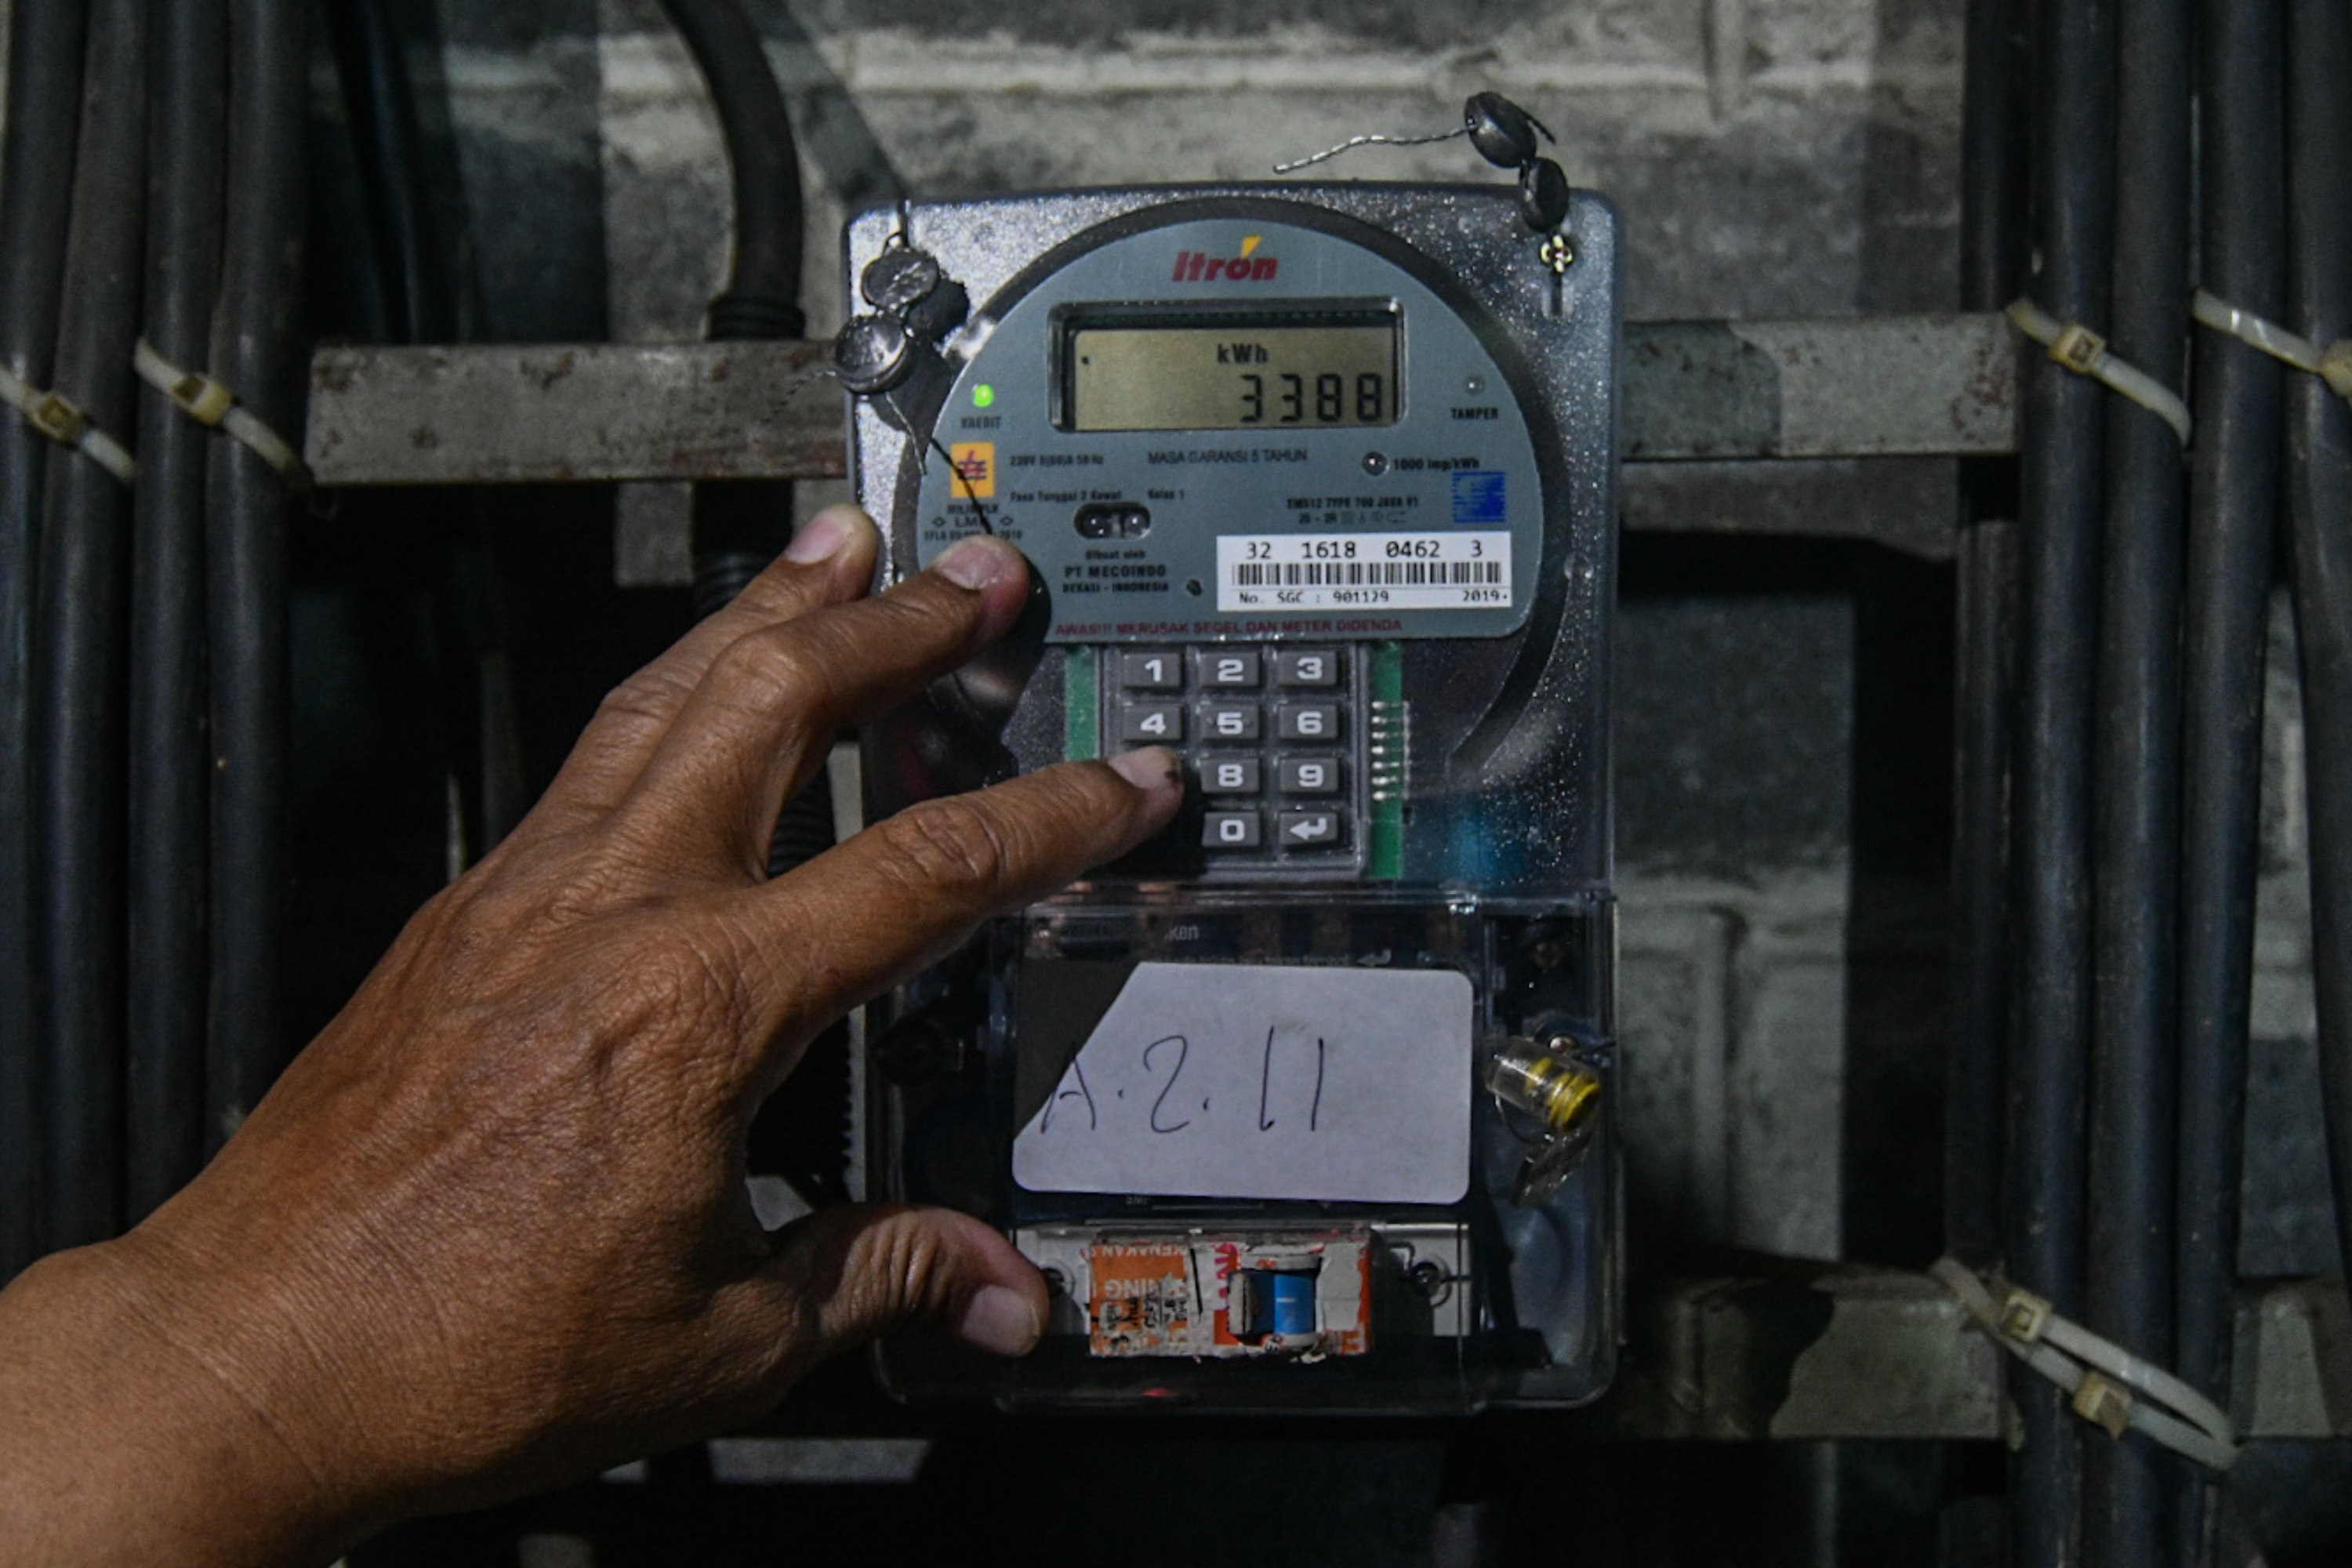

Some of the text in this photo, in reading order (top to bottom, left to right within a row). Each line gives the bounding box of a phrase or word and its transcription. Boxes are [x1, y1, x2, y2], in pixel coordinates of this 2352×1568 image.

[1172, 250, 1279, 283] Itron
[1217, 343, 1269, 365] kWh
[1240, 372, 1383, 423] 3388
[1450, 407, 1499, 421] TAMPER
[1148, 451, 1185, 464] MASA
[1188, 450, 1249, 463] GARANSI
[1261, 448, 1308, 462] TAHUN
[1393, 457, 1425, 470] 1000
[1246, 539, 1483, 559] 32 1618 0462 3
[1065, 564, 1167, 578] PT MECOINDO
[1062, 583, 1101, 593] BEKASI
[1112, 582, 1170, 593] INDONESIA
[1239, 591, 1265, 604] No.
[1276, 591, 1305, 604] SGC
[1332, 590, 1390, 604] 901129
[1116, 621, 1189, 635] MERUSAK
[1193, 619, 1241, 633] SEGEL
[1246, 619, 1278, 633] DAN
[1281, 619, 1331, 633] METER
[1336, 618, 1403, 632] DIDENDA
[1145, 656, 1323, 682] 1 2 3
[1140, 711, 1323, 735] 4 5 6
[1218, 764, 1324, 787] 8 9
[1219, 819, 1246, 842] 0
